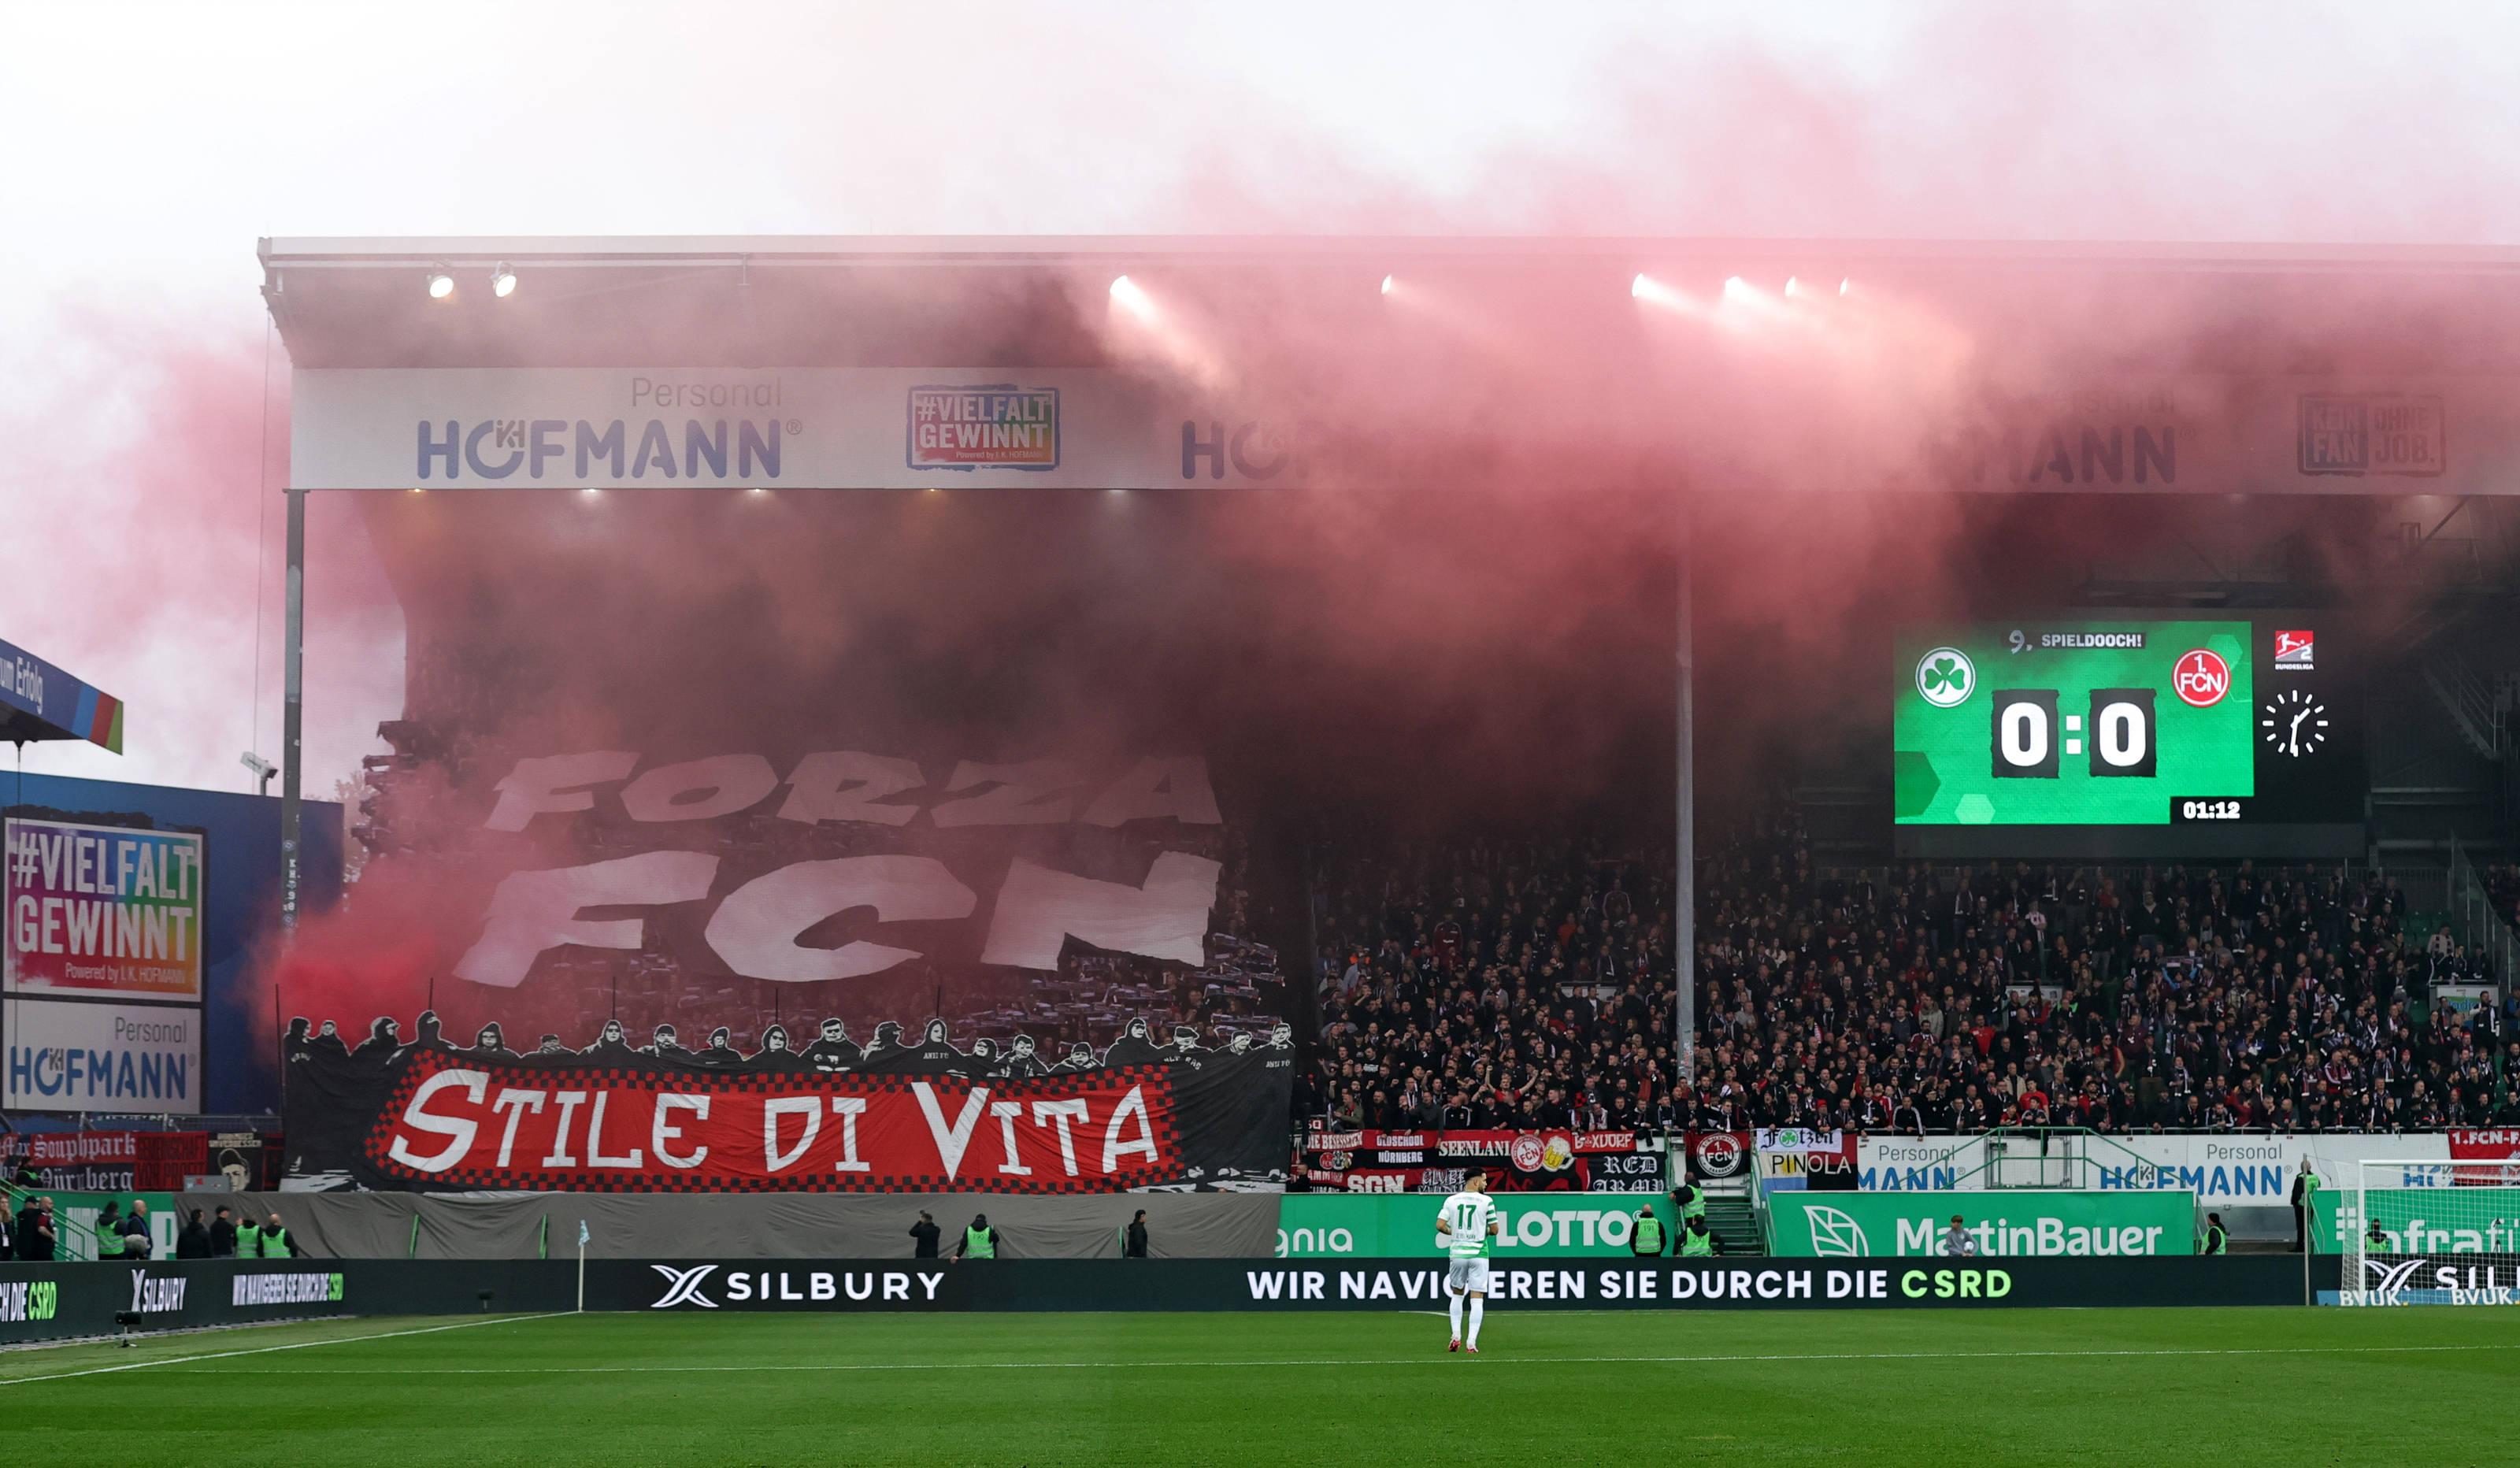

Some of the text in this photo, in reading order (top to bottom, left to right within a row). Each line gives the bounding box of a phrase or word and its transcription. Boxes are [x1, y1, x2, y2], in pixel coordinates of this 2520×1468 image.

[632, 376, 781, 407] Personal
[917, 396, 1050, 421] #VIELFALT
[2312, 400, 2359, 431] KEIN
[2374, 405, 2429, 432] OHNE
[919, 423, 1048, 449] GEWINNT
[2312, 432, 2361, 465] FAN
[2374, 433, 2436, 465] JOB.
[417, 420, 780, 480] HOFMANN
[986, 451, 994, 461] by
[2041, 633, 2143, 647] SPIELDOOCH!
[2300, 647, 2311, 660] 2
[2194, 654, 2207, 673] 1.
[17, 656, 43, 715] Erfolg
[2180, 672, 2222, 693] FCN
[482, 750, 1223, 832] FORZA
[2183, 801, 2241, 819] 01:12
[13, 832, 195, 900] #VIELFALT
[15, 895, 193, 962] GEWINNT
[451, 849, 1221, 988] FCN
[65, 962, 106, 981] Powered
[108, 964, 117, 984] by
[139, 969, 186, 984] HOFMANN
[116, 1016, 187, 1044] Personal
[10, 1046, 187, 1099] HOFMANN
[388, 1069, 1158, 1183] STILE DI VITA
[1377, 1150, 1424, 1163] NÜRNBERG
[1519, 1151, 1540, 1164] FCN
[1603, 1155, 1658, 1175] RED
[1707, 1151, 1732, 1162] FCN
[1772, 1154, 1852, 1175] PINOLA
[1880, 1144, 1955, 1162] Personal
[2207, 1144, 2282, 1161] Personal
[1347, 1174, 1406, 1194] SGN
[1457, 1203, 1477, 1230] 17
[1496, 1209, 1633, 1248] LOTTO
[1896, 1217, 2163, 1257] MatinBauer
[726, 1272, 944, 1300] SILBURY
[1247, 1269, 2012, 1299] WIR NAVIEREN SIE DURCH DIE CSRD
[2436, 1266, 2520, 1291] SIL
[10, 1282, 28, 1322] DIE
[28, 1281, 57, 1321] CSRD
[143, 1277, 187, 1314] SILBURY
